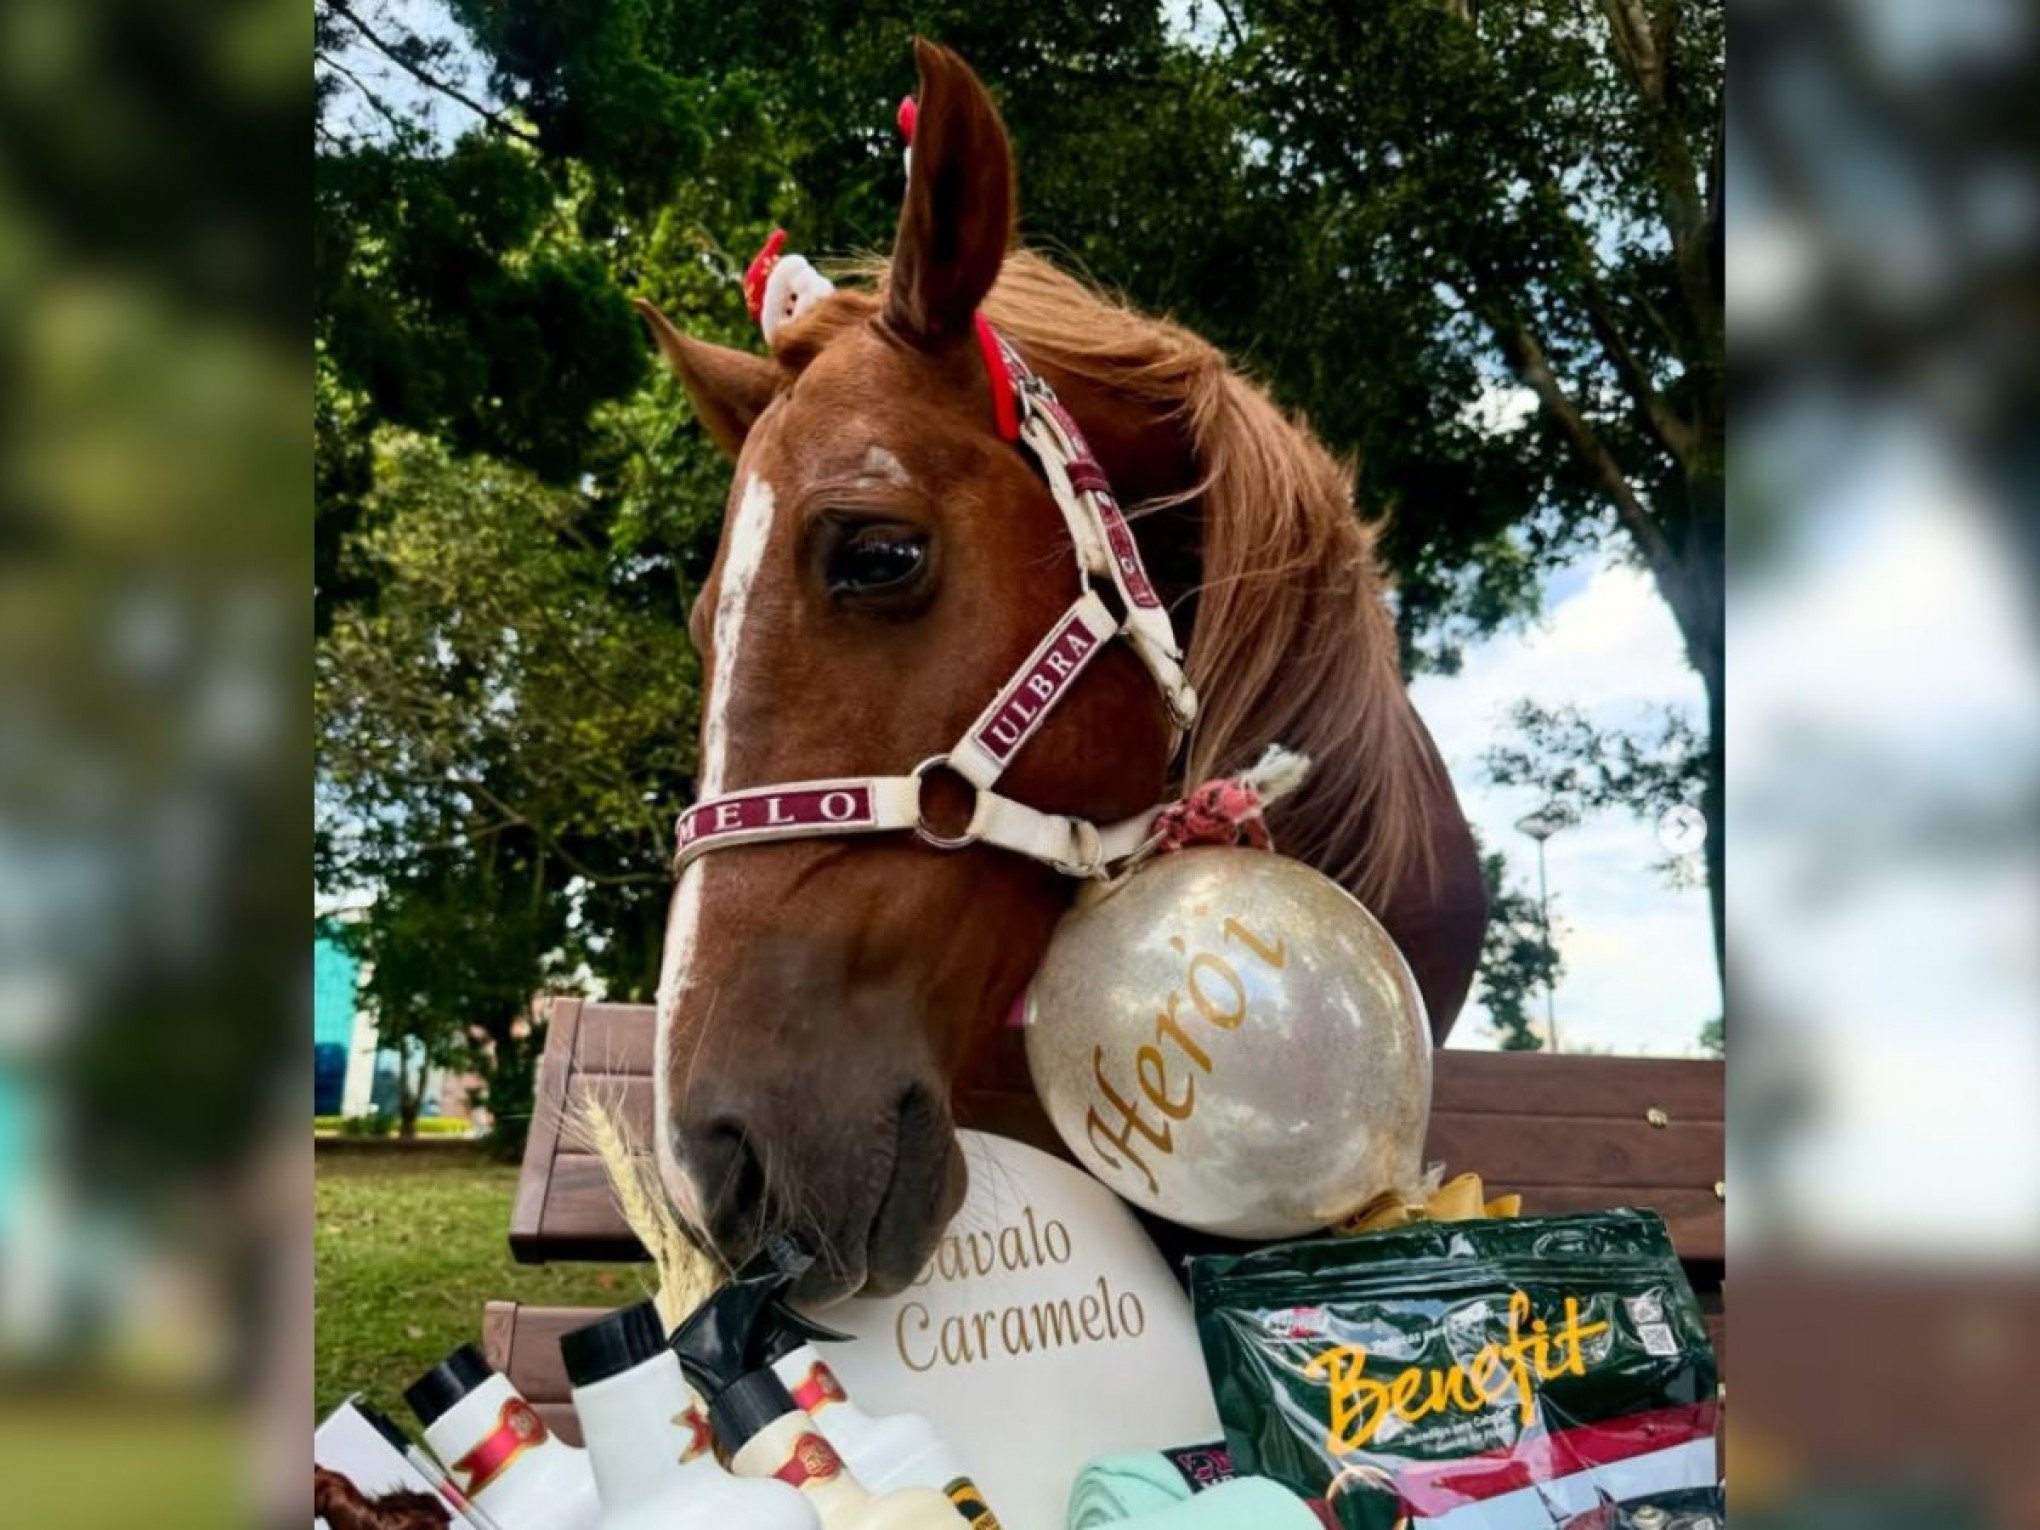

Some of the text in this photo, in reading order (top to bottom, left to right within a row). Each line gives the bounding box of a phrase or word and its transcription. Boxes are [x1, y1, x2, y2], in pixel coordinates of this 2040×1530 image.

[991, 633, 1090, 746] ULBRA
[895, 1275, 1146, 1373] Caramelo
[1304, 1290, 1609, 1456] Benefit
